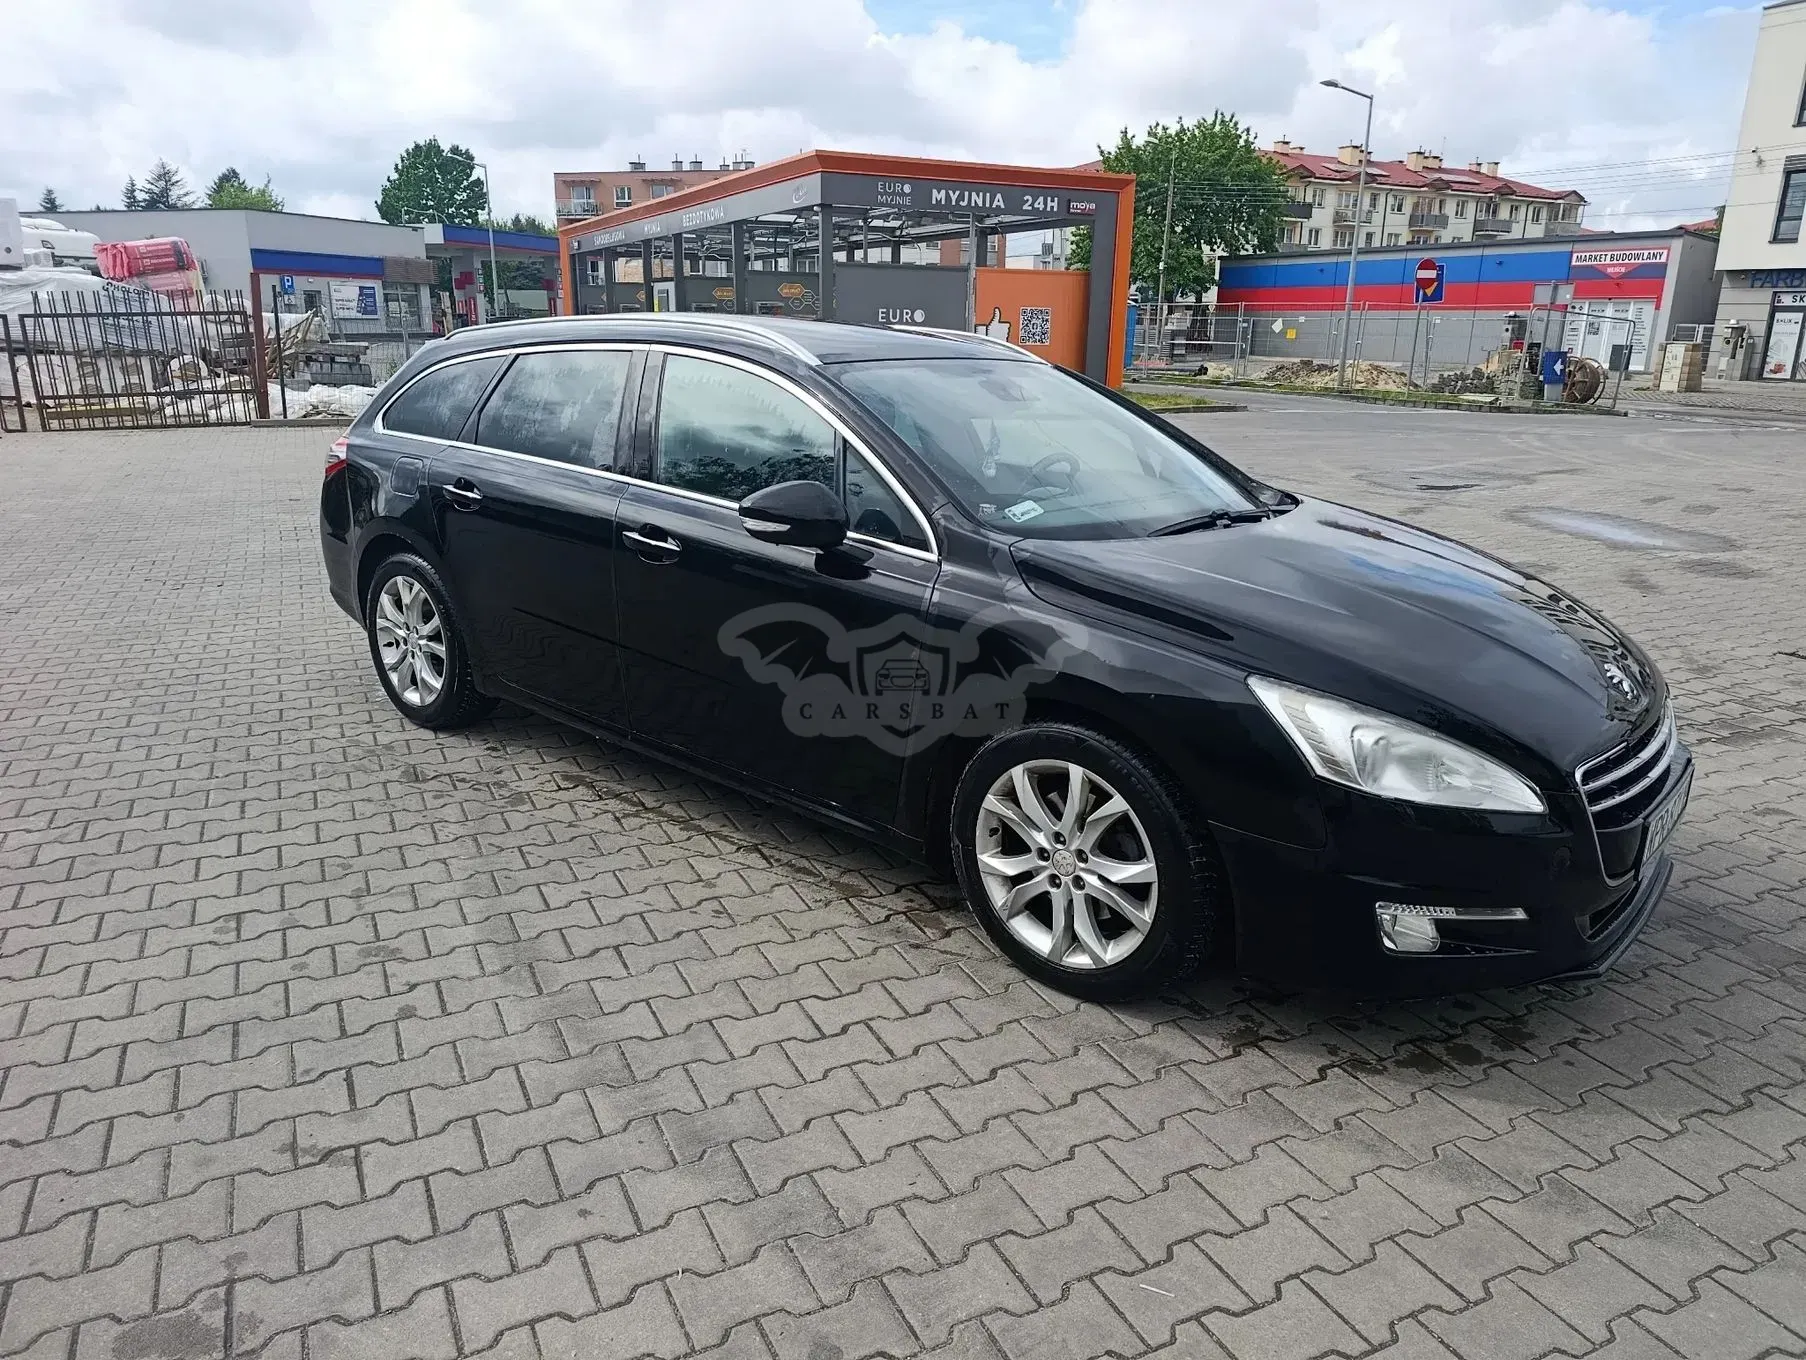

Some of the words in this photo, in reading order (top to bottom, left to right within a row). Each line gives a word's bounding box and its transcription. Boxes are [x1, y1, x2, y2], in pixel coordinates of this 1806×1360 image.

[878, 181, 912, 194] EURO
[877, 195, 912, 205] MYJNIE
[931, 188, 1005, 209] MYJNIA
[1022, 195, 1059, 212] 24H
[1070, 201, 1096, 212] moya
[682, 207, 725, 227] BEZDOTYKOWA
[1575, 253, 1609, 263] MARKET
[1610, 251, 1664, 262] BUDOWLANY
[284, 276, 292, 288] P
[878, 308, 926, 323] EURO
